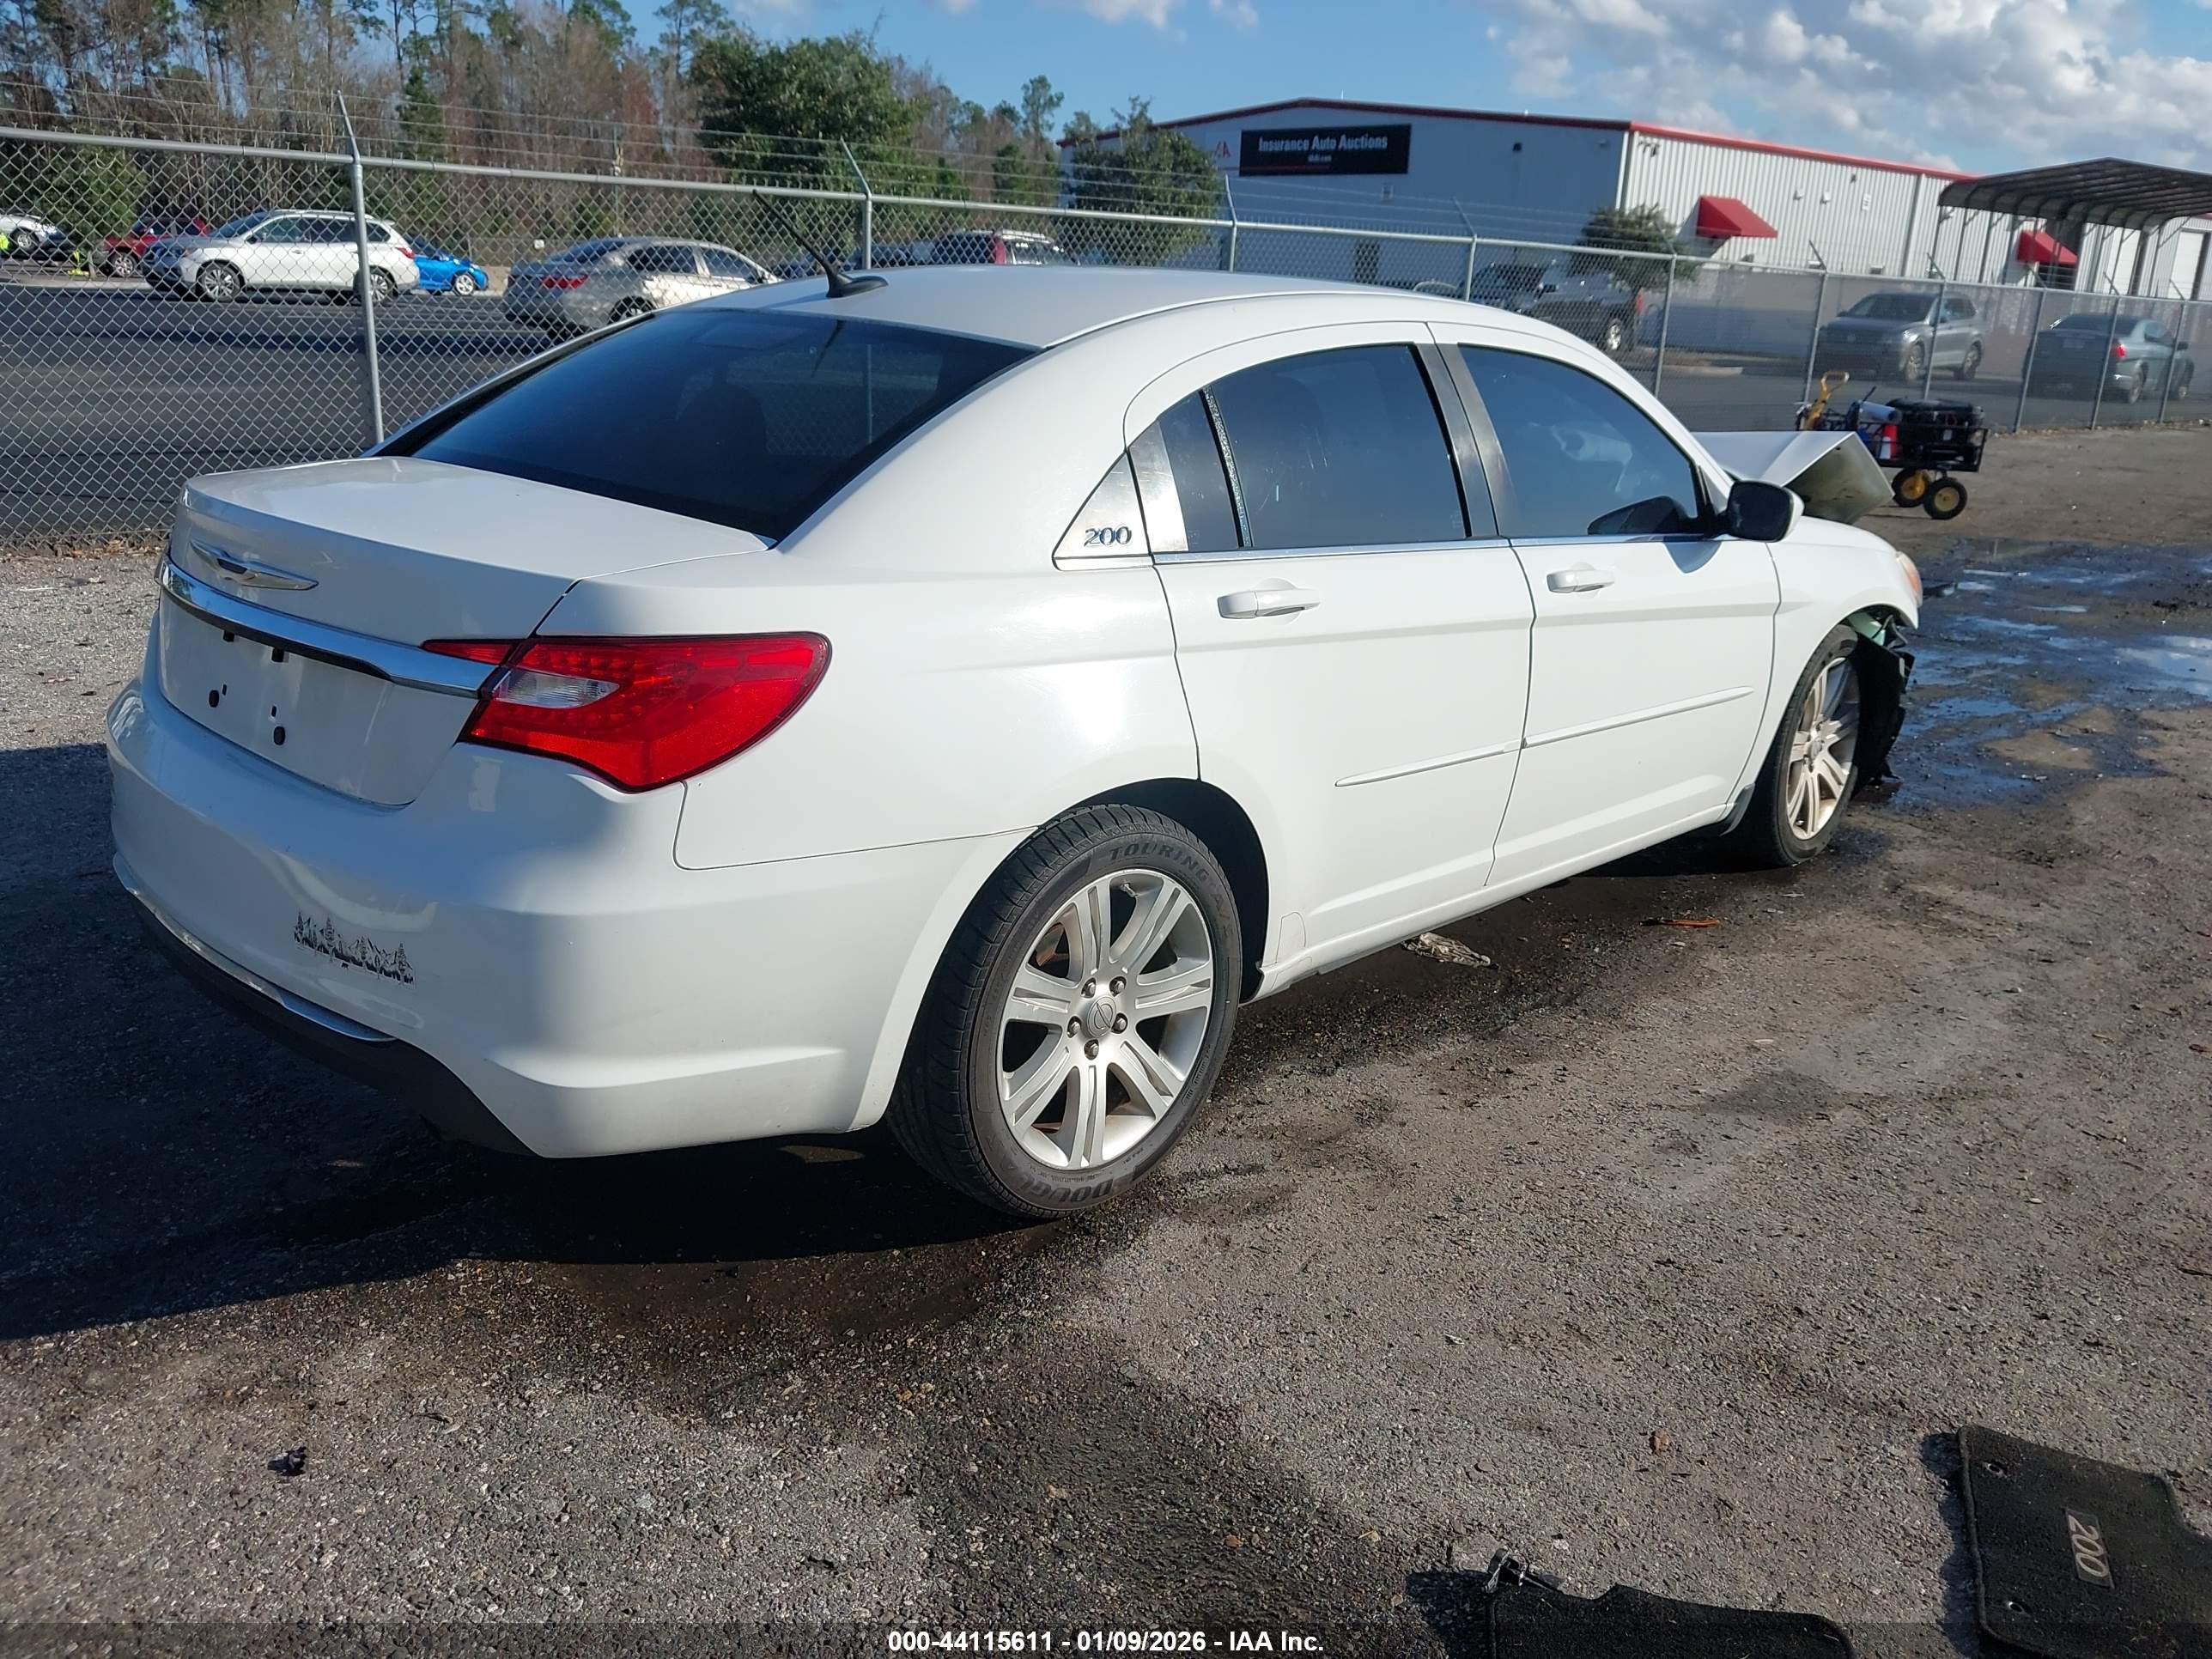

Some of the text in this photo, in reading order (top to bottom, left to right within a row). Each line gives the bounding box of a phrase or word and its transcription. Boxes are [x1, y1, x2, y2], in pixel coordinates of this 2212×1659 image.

[1258, 133, 1389, 152] Insurance Auto Auctions
[1084, 526, 1132, 546] 200
[1109, 842, 1210, 881] TOURING
[2068, 1514, 2110, 1577] 200
